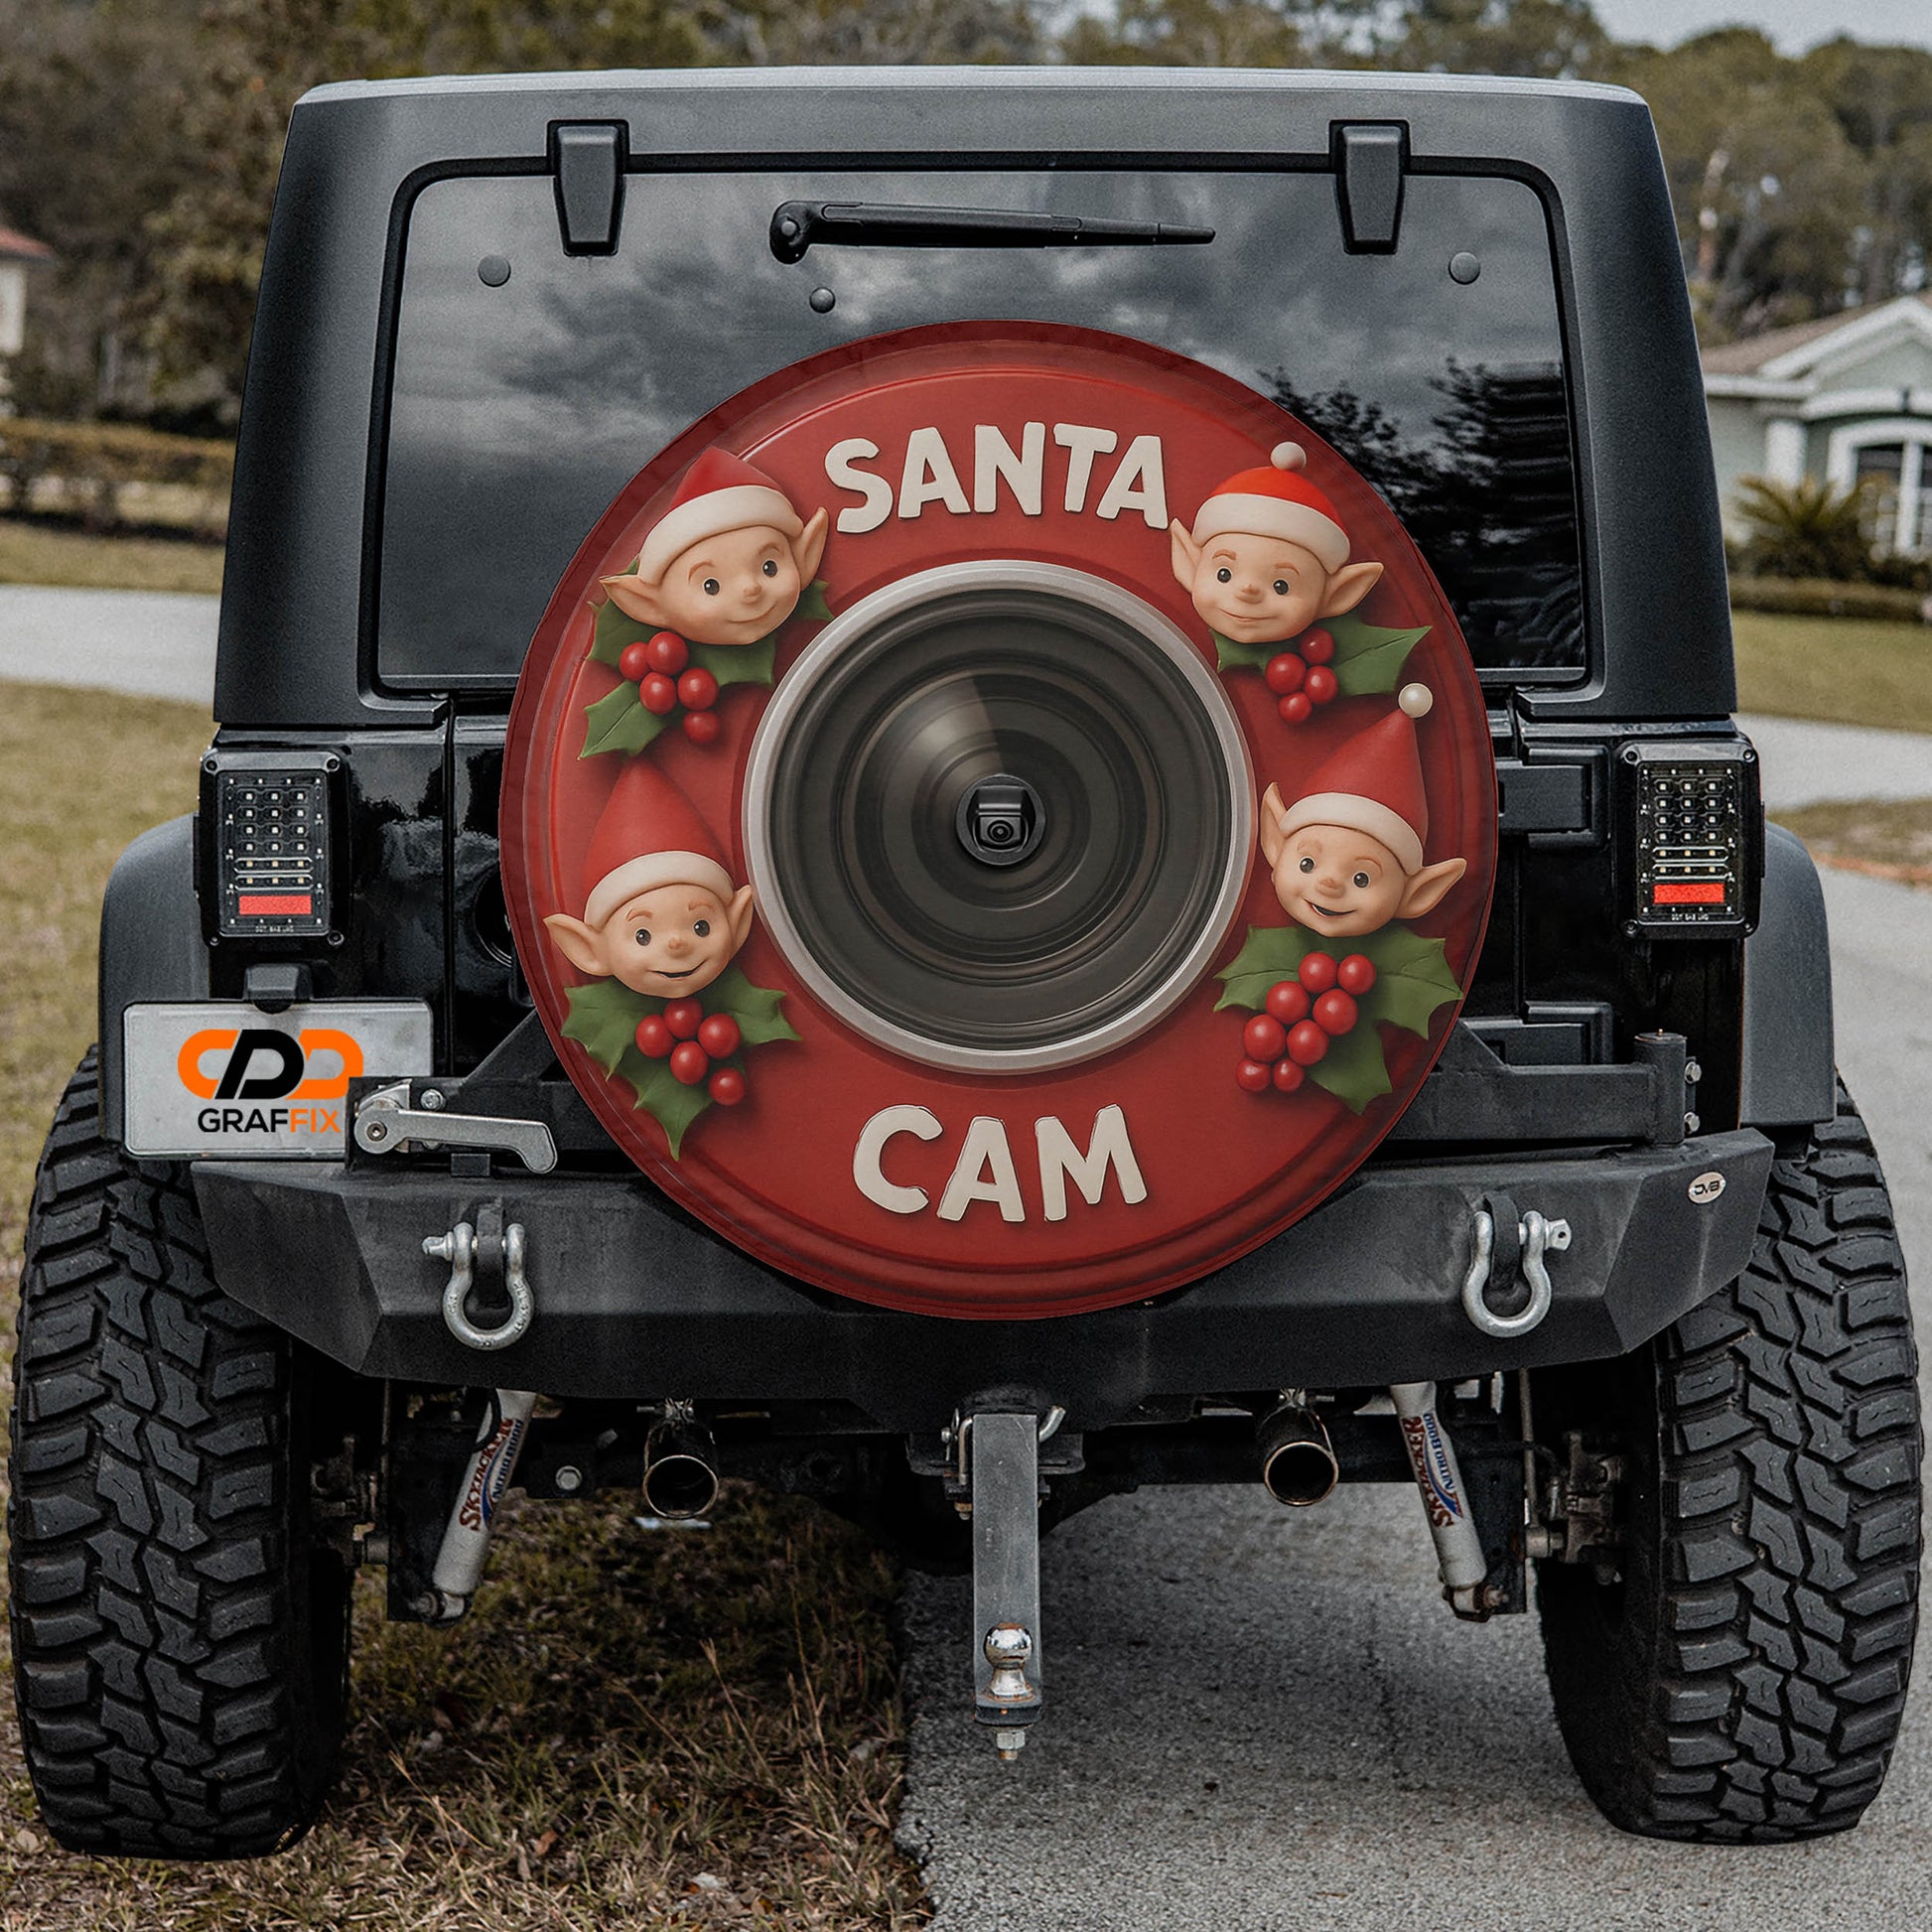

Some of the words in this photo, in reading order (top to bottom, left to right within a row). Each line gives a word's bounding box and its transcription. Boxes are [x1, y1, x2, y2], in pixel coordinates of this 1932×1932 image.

[824, 421, 1169, 533] SANTA
[198, 1108, 341, 1133] GRAFFIX
[853, 1103, 1148, 1222] CAM
